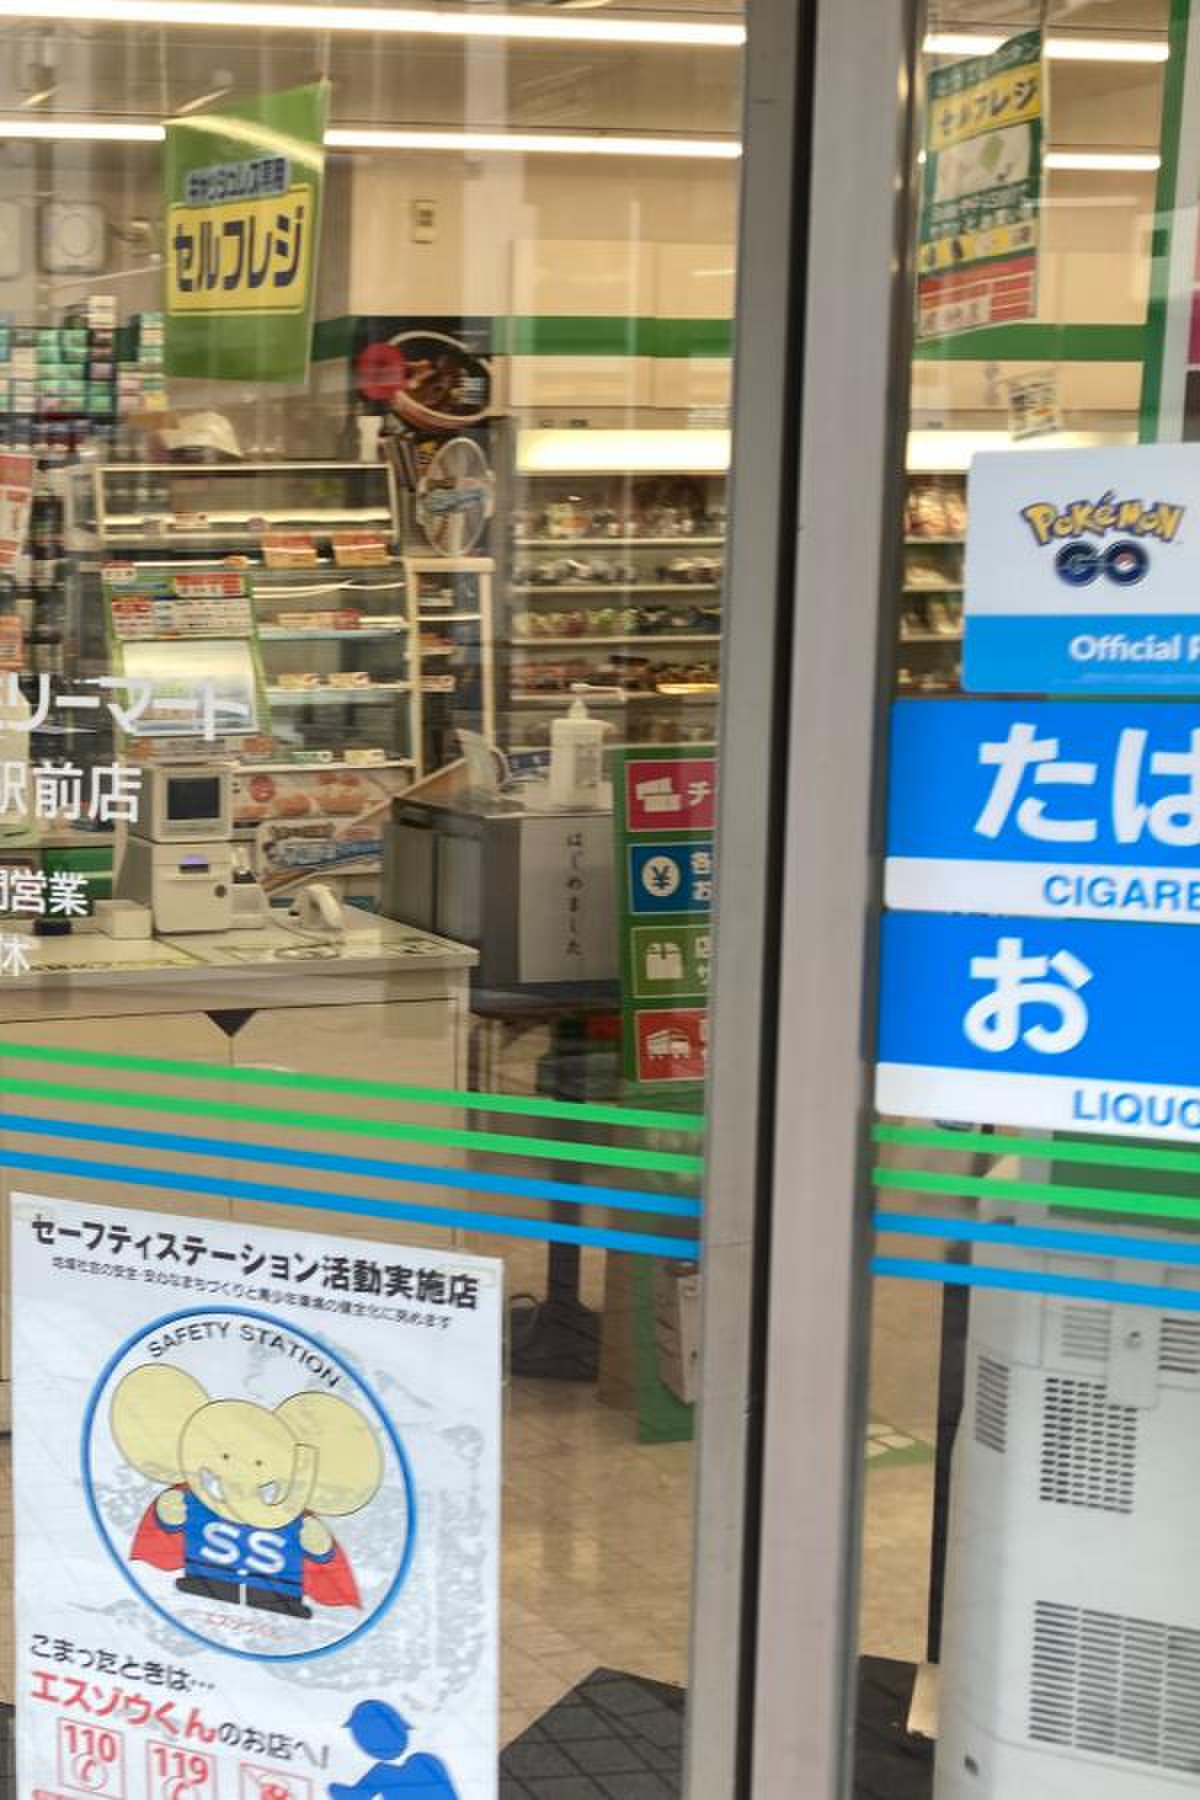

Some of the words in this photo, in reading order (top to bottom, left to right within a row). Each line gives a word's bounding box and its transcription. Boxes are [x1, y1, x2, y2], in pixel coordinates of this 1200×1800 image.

[173, 205, 305, 293] セルフレジ
[1054, 539, 1150, 588] GO
[1068, 633, 1181, 662] Official
[962, 936, 1095, 1055] お
[31, 1213, 480, 1311] セーフティステーション活動実施店
[148, 1321, 231, 1358] SAFETY
[239, 1323, 343, 1388] STATION
[200, 1521, 287, 1574] SS
[64, 1724, 117, 1763] 110
[154, 1747, 210, 1785] 119
